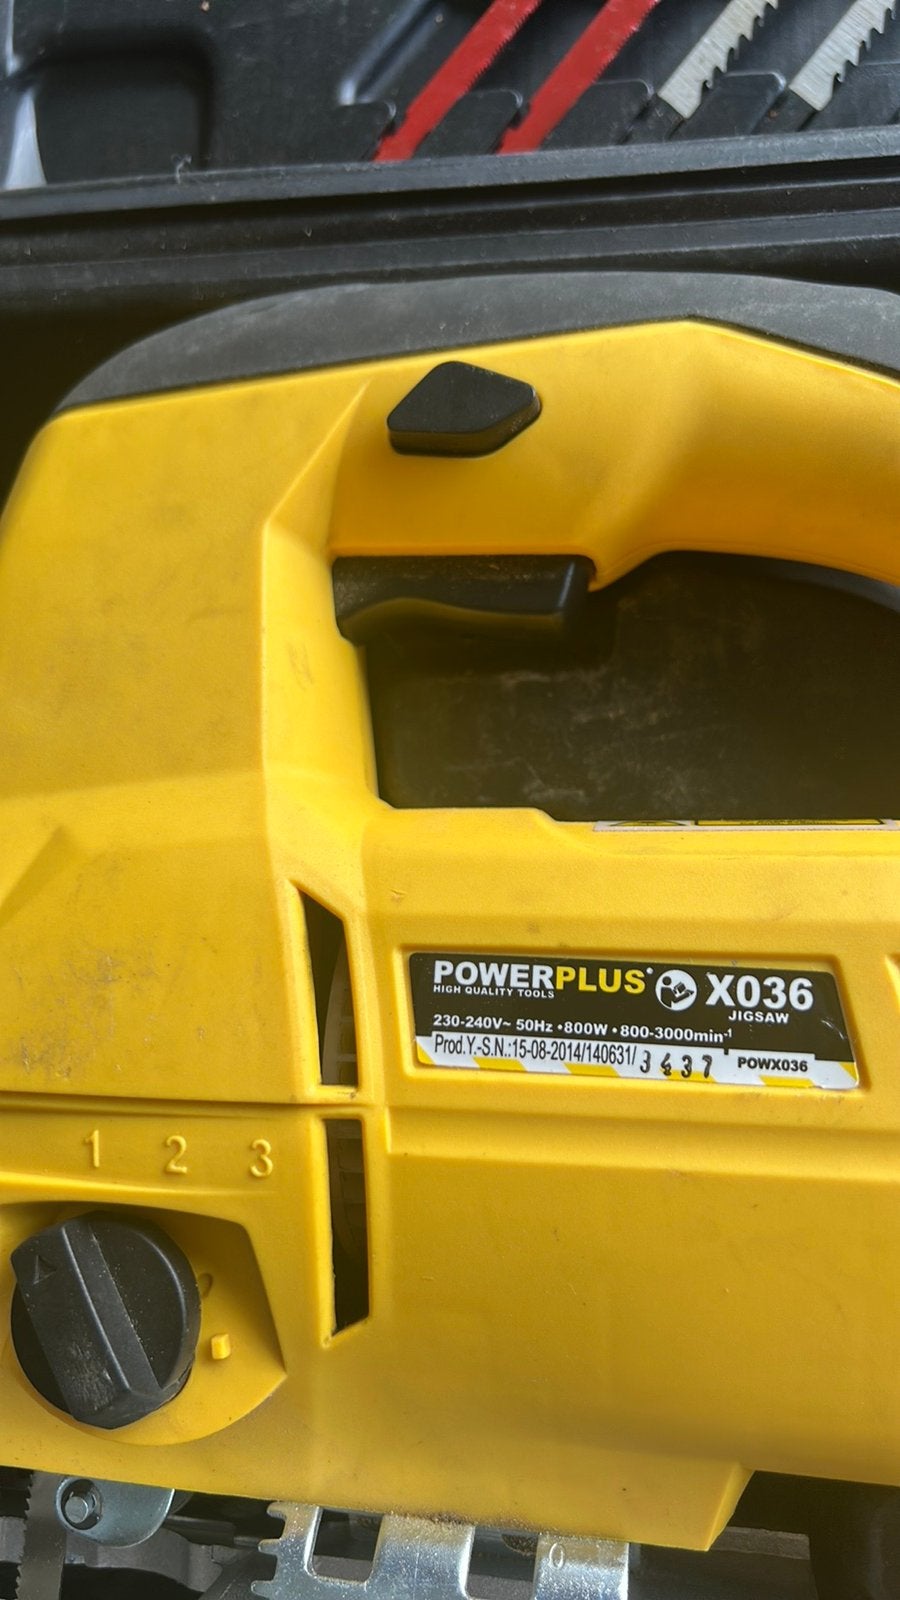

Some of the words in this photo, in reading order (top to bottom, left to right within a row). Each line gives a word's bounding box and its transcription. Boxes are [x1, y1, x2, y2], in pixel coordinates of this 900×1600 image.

[433, 959, 646, 995] POWERPLUS
[433, 984, 461, 994] HIGH
[465, 986, 513, 997] QUALITY
[518, 988, 555, 999] TOOLS
[706, 973, 814, 1011] X036
[516, 1018, 553, 1033] 50Hz
[728, 1010, 789, 1024] JIGSAW
[738, 1056, 808, 1073] POWX036
[84, 1129, 100, 1168] 1
[164, 1135, 188, 1174] 2
[250, 1138, 274, 1178] 3
